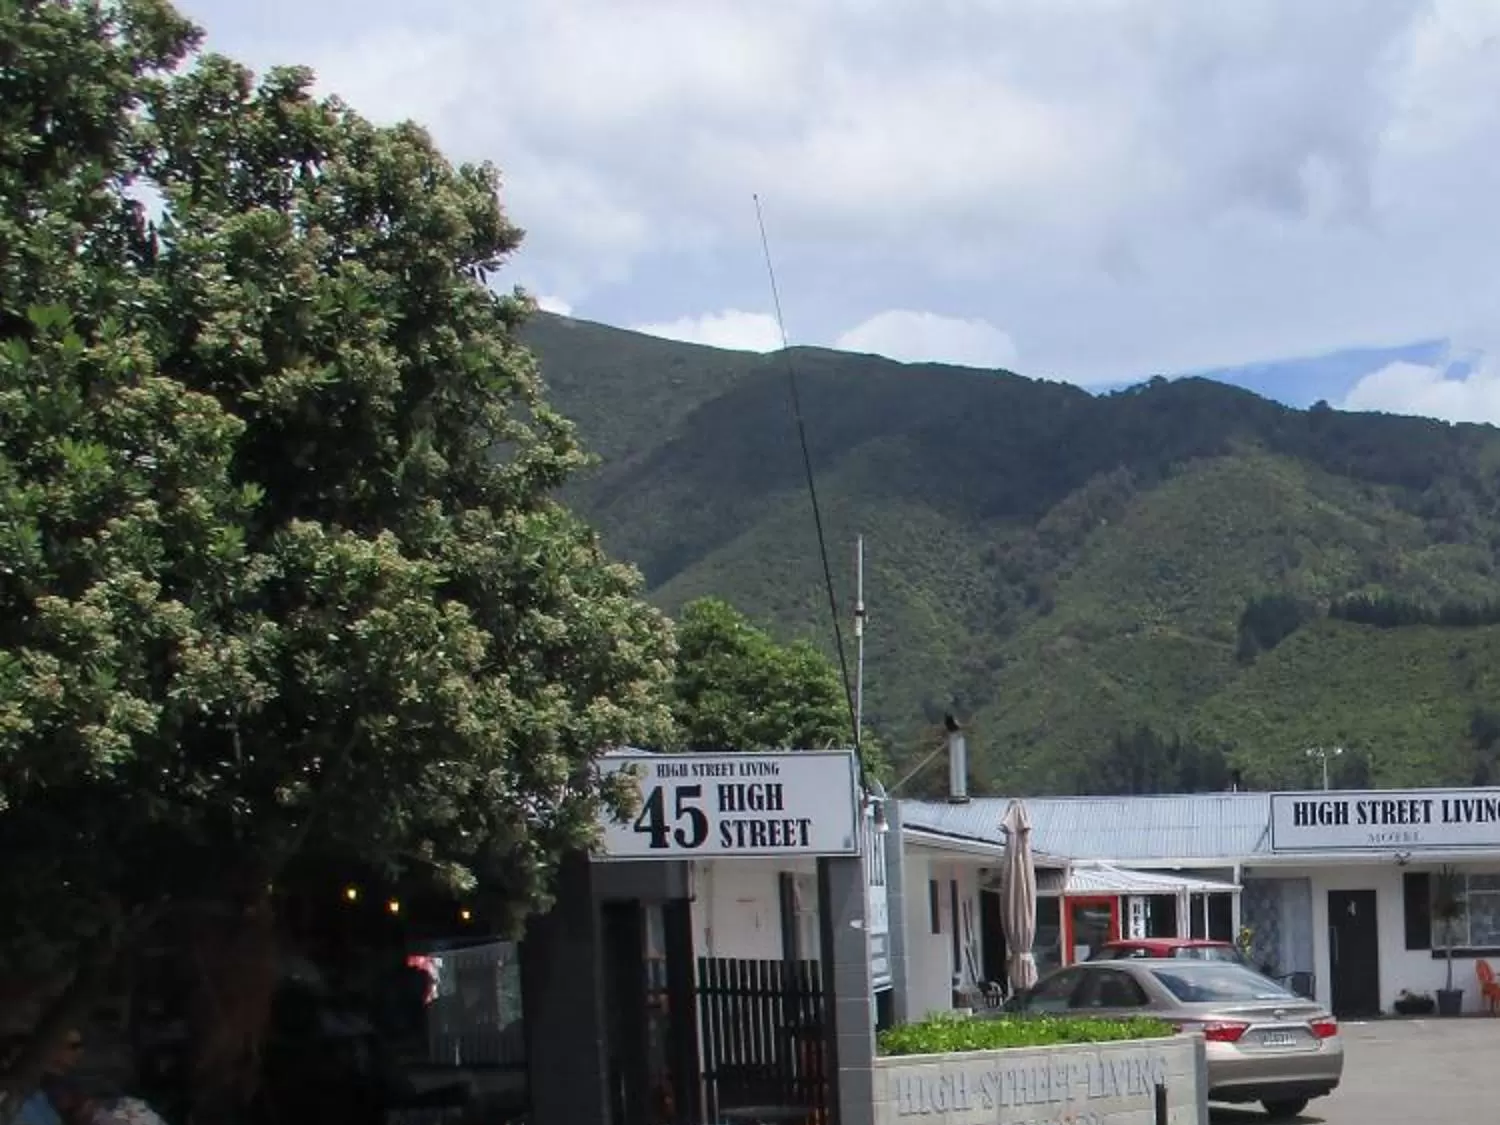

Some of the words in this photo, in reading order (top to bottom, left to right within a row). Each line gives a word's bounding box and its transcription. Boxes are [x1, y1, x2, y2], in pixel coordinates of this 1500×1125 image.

[656, 761, 689, 778] HIGH
[692, 762, 735, 778] STREET
[739, 761, 780, 777] LIVING
[717, 783, 784, 813] HIGH
[1293, 801, 1349, 827] HIGH
[1357, 799, 1435, 825] STREET
[633, 784, 709, 849] 45
[719, 818, 811, 849] STREET
[897, 1071, 972, 1117] HIGH
[979, 1061, 1075, 1110] STREET
[1086, 1056, 1169, 1100] LIVING
